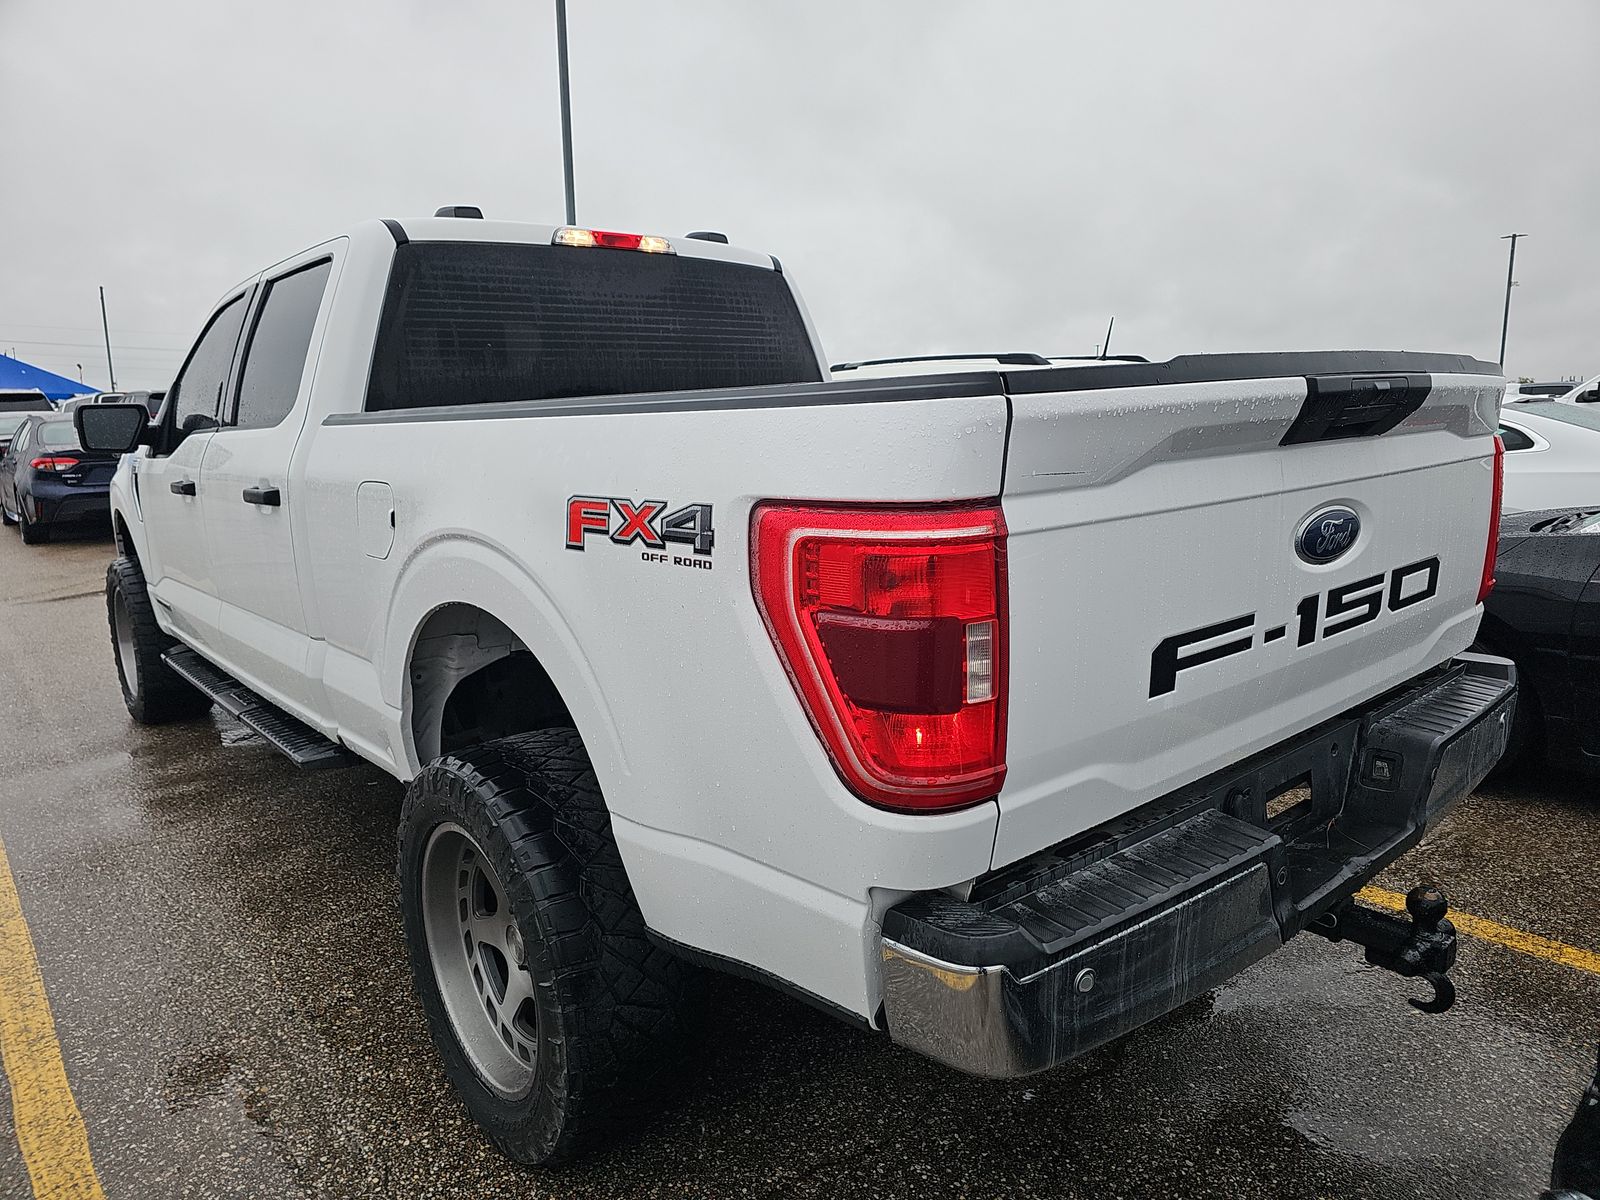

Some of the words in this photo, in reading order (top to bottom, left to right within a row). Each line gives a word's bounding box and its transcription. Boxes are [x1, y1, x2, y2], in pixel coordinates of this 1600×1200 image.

[565, 495, 715, 555] FX4
[1316, 518, 1352, 553] Ford
[641, 552, 668, 564] OFF
[673, 556, 713, 570] ROAD
[1148, 555, 1441, 700] F-150
